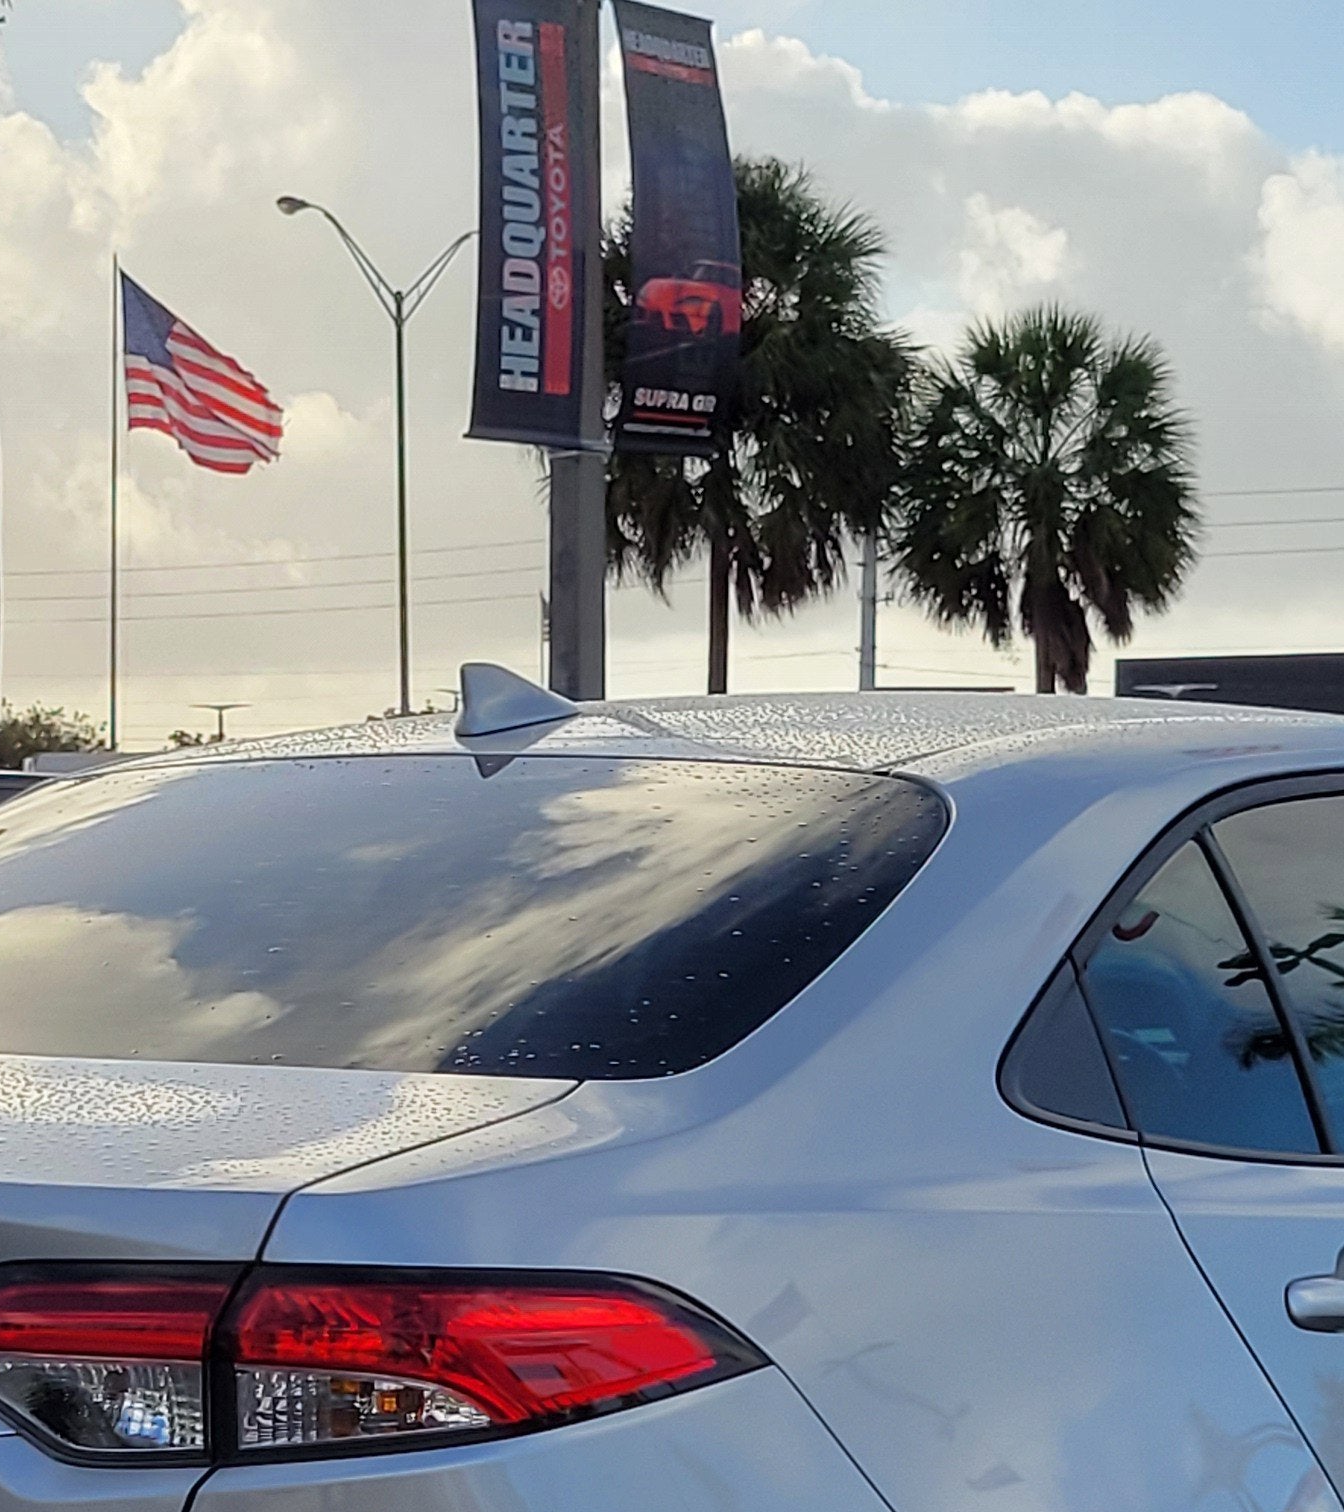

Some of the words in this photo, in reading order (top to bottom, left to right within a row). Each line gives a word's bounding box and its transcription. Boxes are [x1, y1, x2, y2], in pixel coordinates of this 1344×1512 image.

[498, 18, 545, 394] HEADQUARTER
[547, 125, 565, 261] TOYOTA
[634, 387, 689, 411] SUPRA
